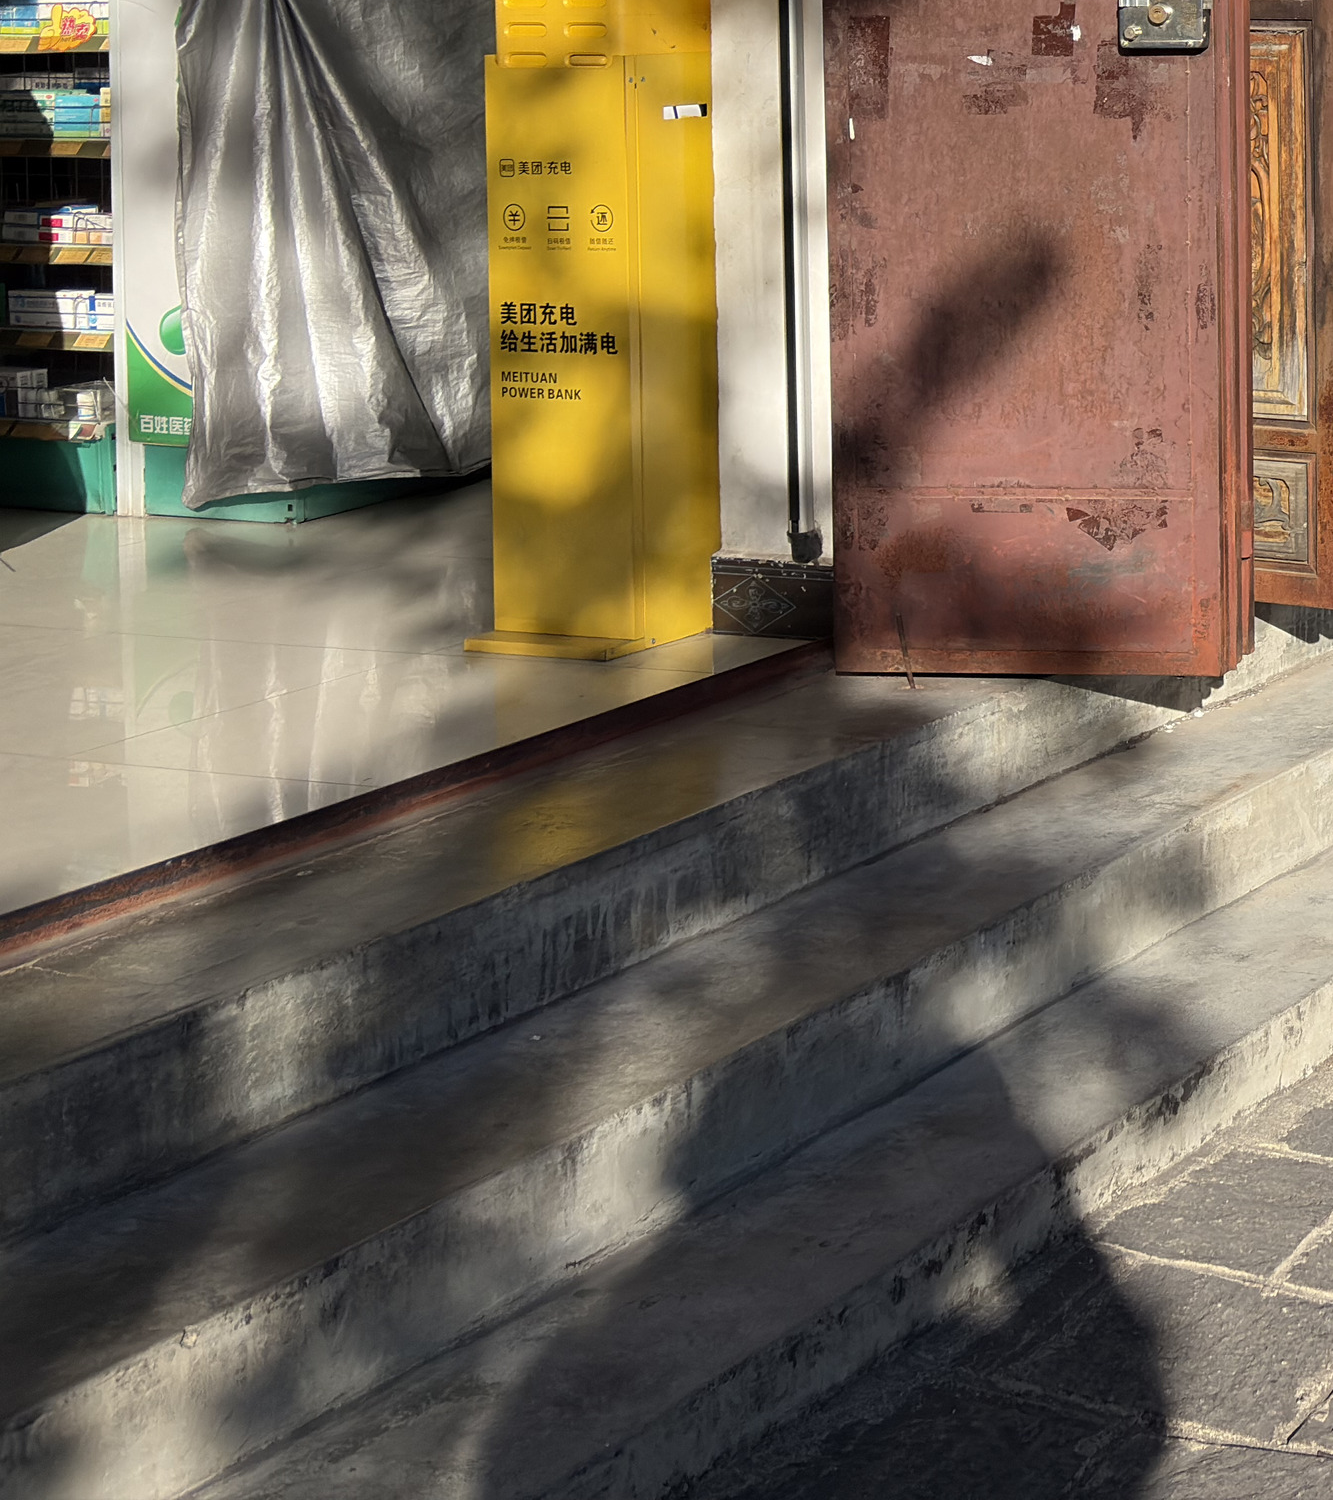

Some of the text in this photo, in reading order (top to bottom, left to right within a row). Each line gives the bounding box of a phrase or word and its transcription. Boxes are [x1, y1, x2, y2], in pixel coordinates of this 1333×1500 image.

[500, 301, 578, 326] 美团充电
[500, 329, 619, 355] 给生活加满电
[501, 371, 558, 384] MEITUAN
[501, 387, 582, 401] POWER BANK
